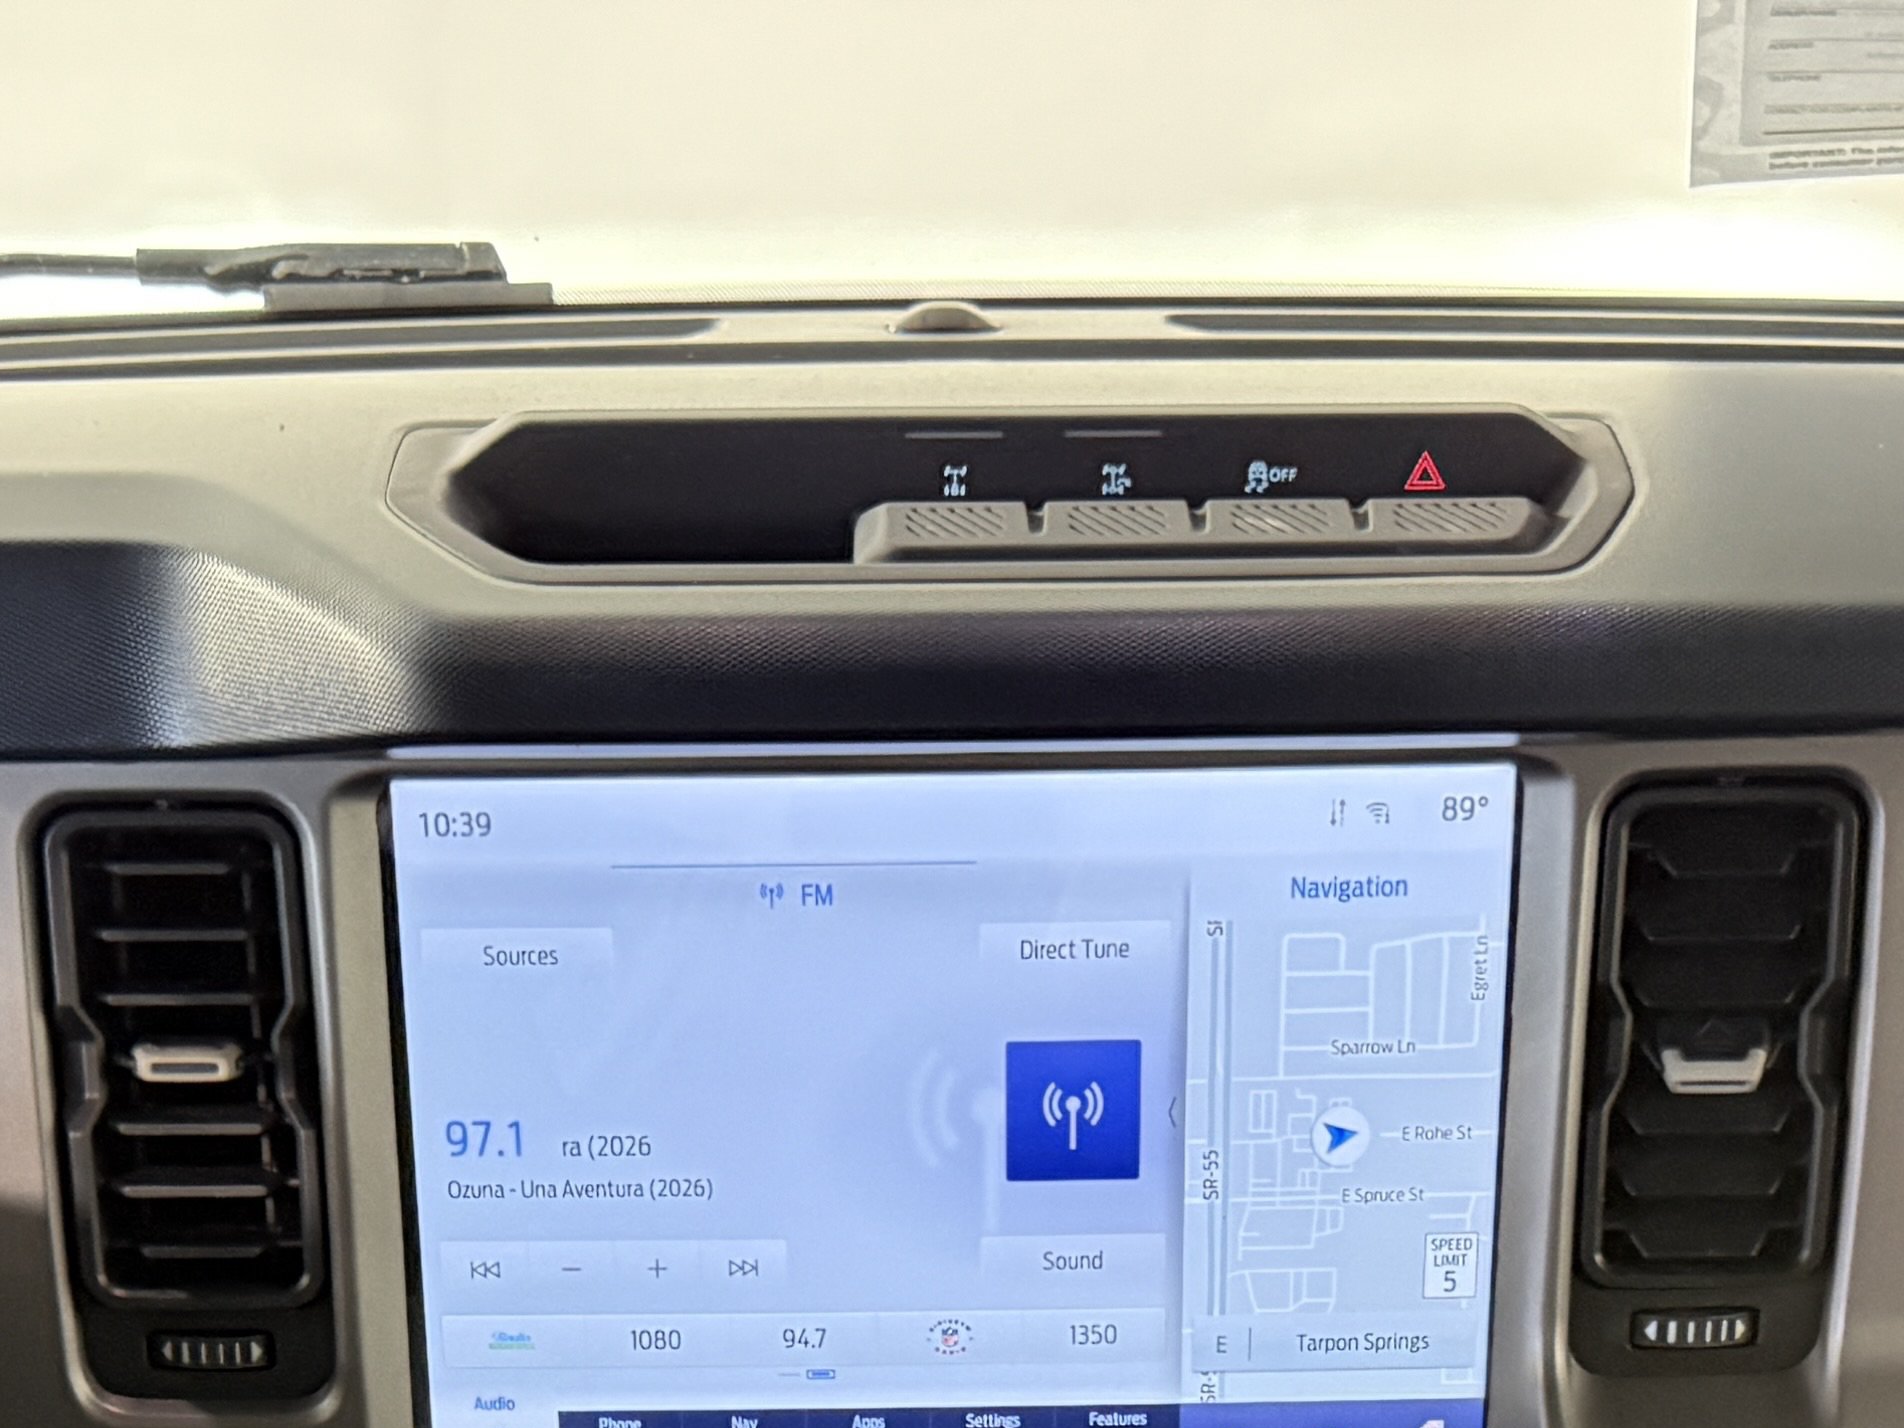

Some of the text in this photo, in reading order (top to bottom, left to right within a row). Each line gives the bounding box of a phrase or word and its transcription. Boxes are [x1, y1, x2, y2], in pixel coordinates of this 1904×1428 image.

[1269, 466, 1298, 482] OFF
[1441, 795, 1489, 821] 89°
[418, 811, 492, 838] 10:39
[801, 884, 834, 907] FM
[1290, 876, 1408, 902] Navigation
[483, 944, 559, 967] Sources
[1020, 939, 1130, 960] Direct Tune
[1471, 935, 1488, 1002] Egret Ln
[1331, 1039, 1416, 1056] Sparrow Ln
[445, 1120, 523, 1158] 97.1
[1402, 1127, 1411, 1141] E
[1456, 1125, 1472, 1140] St
[562, 1135, 651, 1161] ra (2026
[1203, 1150, 1219, 1200] SR-55
[448, 1180, 505, 1200] Ozuna
[521, 1180, 557, 1199] Una
[562, 1179, 644, 1199] Aventura
[650, 1178, 713, 1200] (2026)
[1342, 1187, 1424, 1205] E Spruce St
[1431, 1237, 1473, 1252] SPEED
[1042, 1250, 1103, 1271] Sound
[1433, 1253, 1467, 1268] LIMIT
[1443, 1270, 1457, 1293] 5
[631, 1324, 1117, 1351] 1080 94.7 1350
[1216, 1333, 1430, 1354] E Tarpon Springs
[474, 1397, 515, 1411] Audio
[1089, 1411, 1147, 1427] Features
